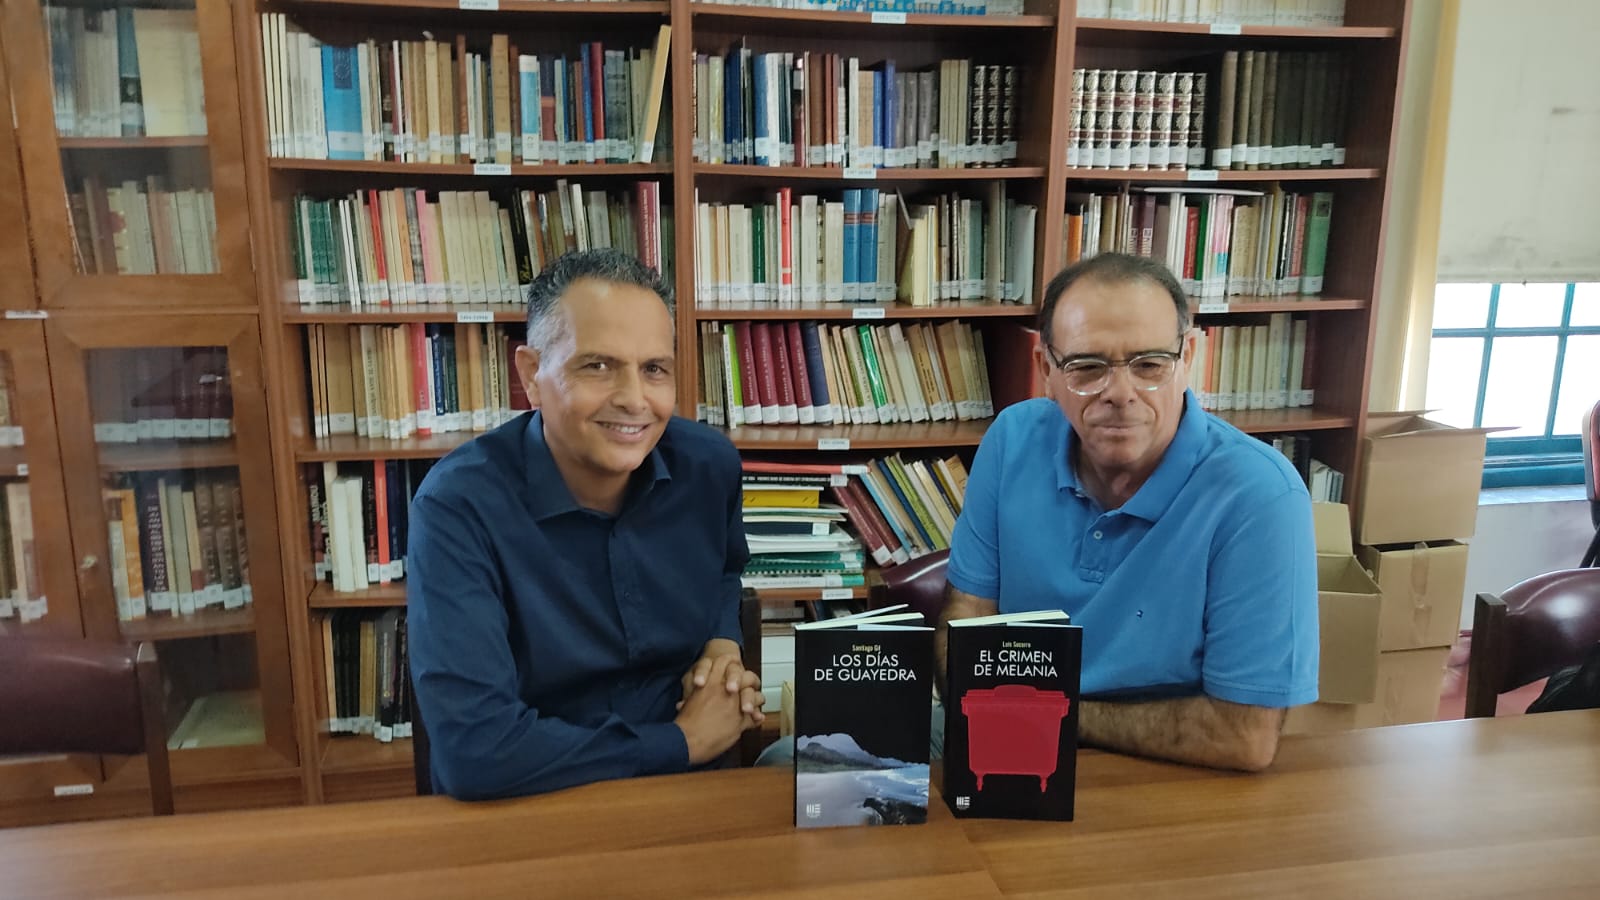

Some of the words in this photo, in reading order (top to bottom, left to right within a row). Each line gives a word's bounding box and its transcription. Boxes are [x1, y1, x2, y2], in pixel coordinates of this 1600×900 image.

[852, 644, 874, 653] Santiago
[873, 644, 881, 652] Gil
[833, 654, 861, 667] LOS
[866, 650, 899, 667] DÍAS
[980, 650, 994, 662] EL
[998, 650, 1053, 663] CRIMEN
[814, 668, 834, 681] DE
[838, 668, 917, 681] GUAYEDRA
[974, 664, 993, 677] DE
[996, 664, 1058, 678] MELANIA
